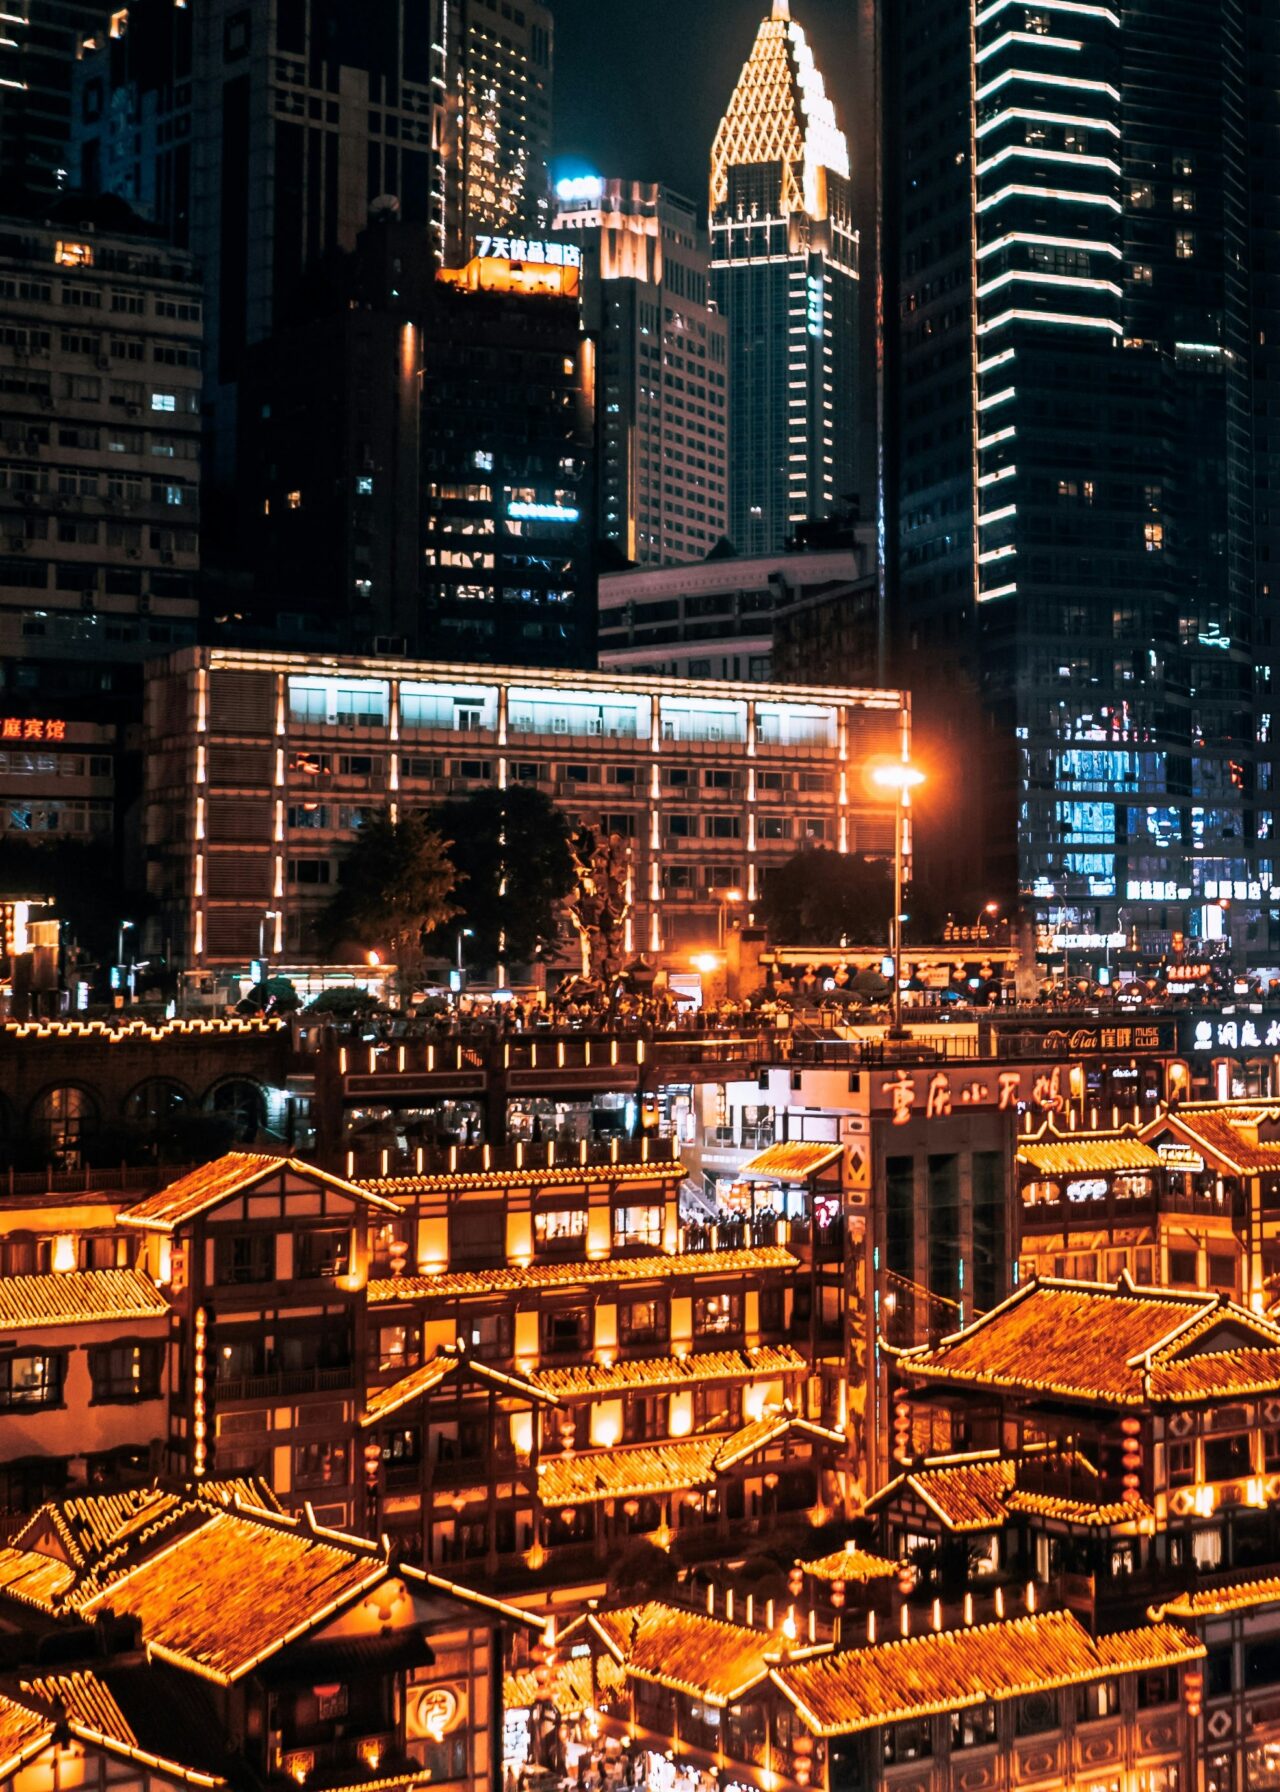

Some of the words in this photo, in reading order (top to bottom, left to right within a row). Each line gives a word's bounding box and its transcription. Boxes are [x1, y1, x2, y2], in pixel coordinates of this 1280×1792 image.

[476, 235, 580, 267] 7天优品酒店
[0, 718, 65, 740] 庭宾馆
[1135, 1027, 1159, 1036] MUSIC
[1135, 1038, 1159, 1047] CLUB
[882, 1067, 1063, 1126] 重庆小天鹅
